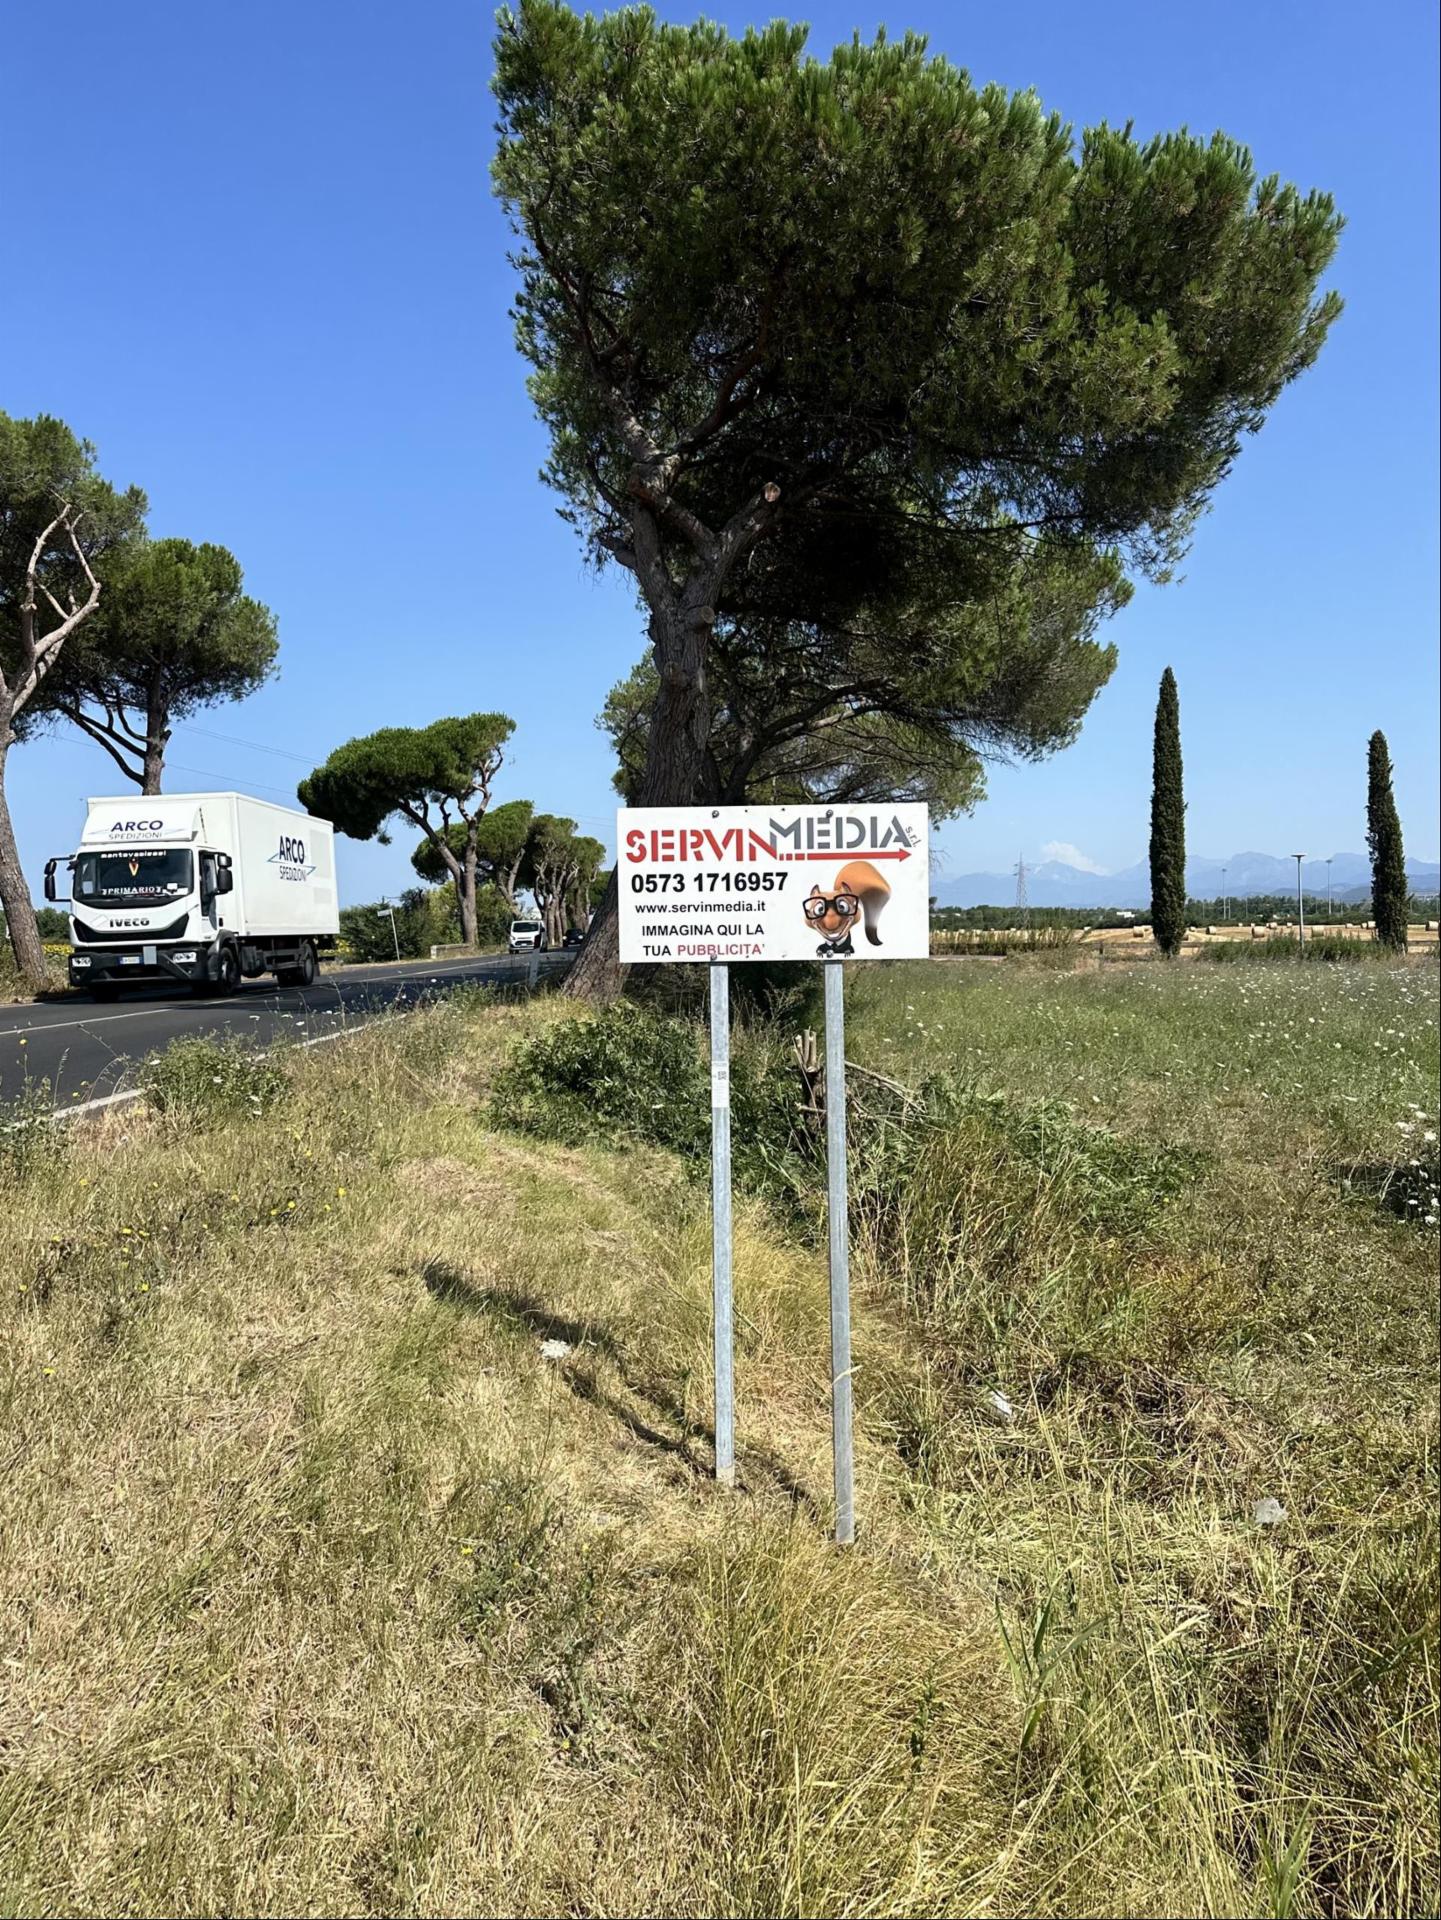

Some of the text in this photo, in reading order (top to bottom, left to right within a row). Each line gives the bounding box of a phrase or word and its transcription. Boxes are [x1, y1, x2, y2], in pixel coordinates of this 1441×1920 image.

[111, 820, 163, 832] ARCO
[109, 832, 162, 840] SPEDIZIONI
[279, 835, 304, 864] ARCO
[631, 872, 788, 893] 0573 1716957
[635, 900, 766, 913] www.servinmedia.it
[110, 918, 150, 928] IVECO
[642, 923, 764, 937] IMMAGINA QUI LA
[643, 945, 671, 957] TUA
